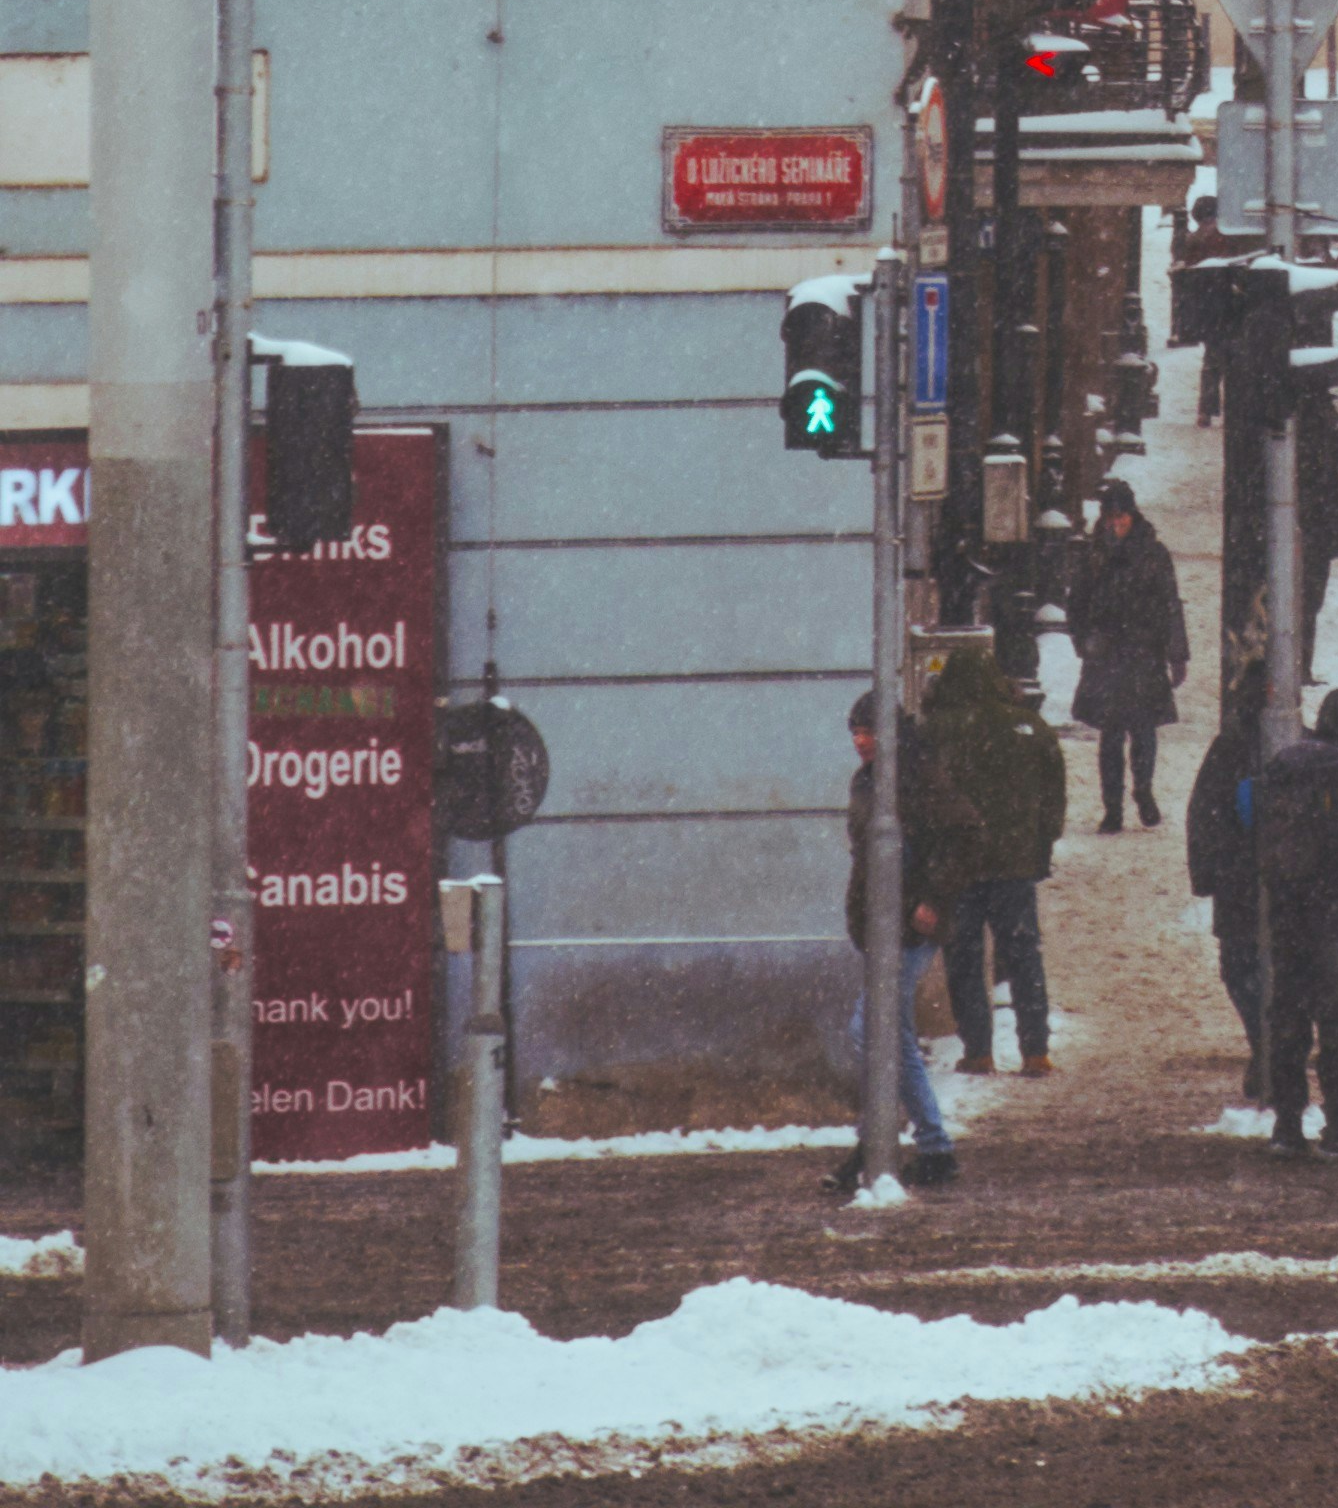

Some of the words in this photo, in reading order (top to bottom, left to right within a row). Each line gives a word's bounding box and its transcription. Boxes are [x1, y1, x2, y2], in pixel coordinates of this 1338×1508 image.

[0, 468, 91, 526] RK
[251, 992, 329, 1023] hank
[340, 990, 413, 1028] you!
[250, 1083, 314, 1113] elen
[326, 1079, 426, 1112] Dank!
